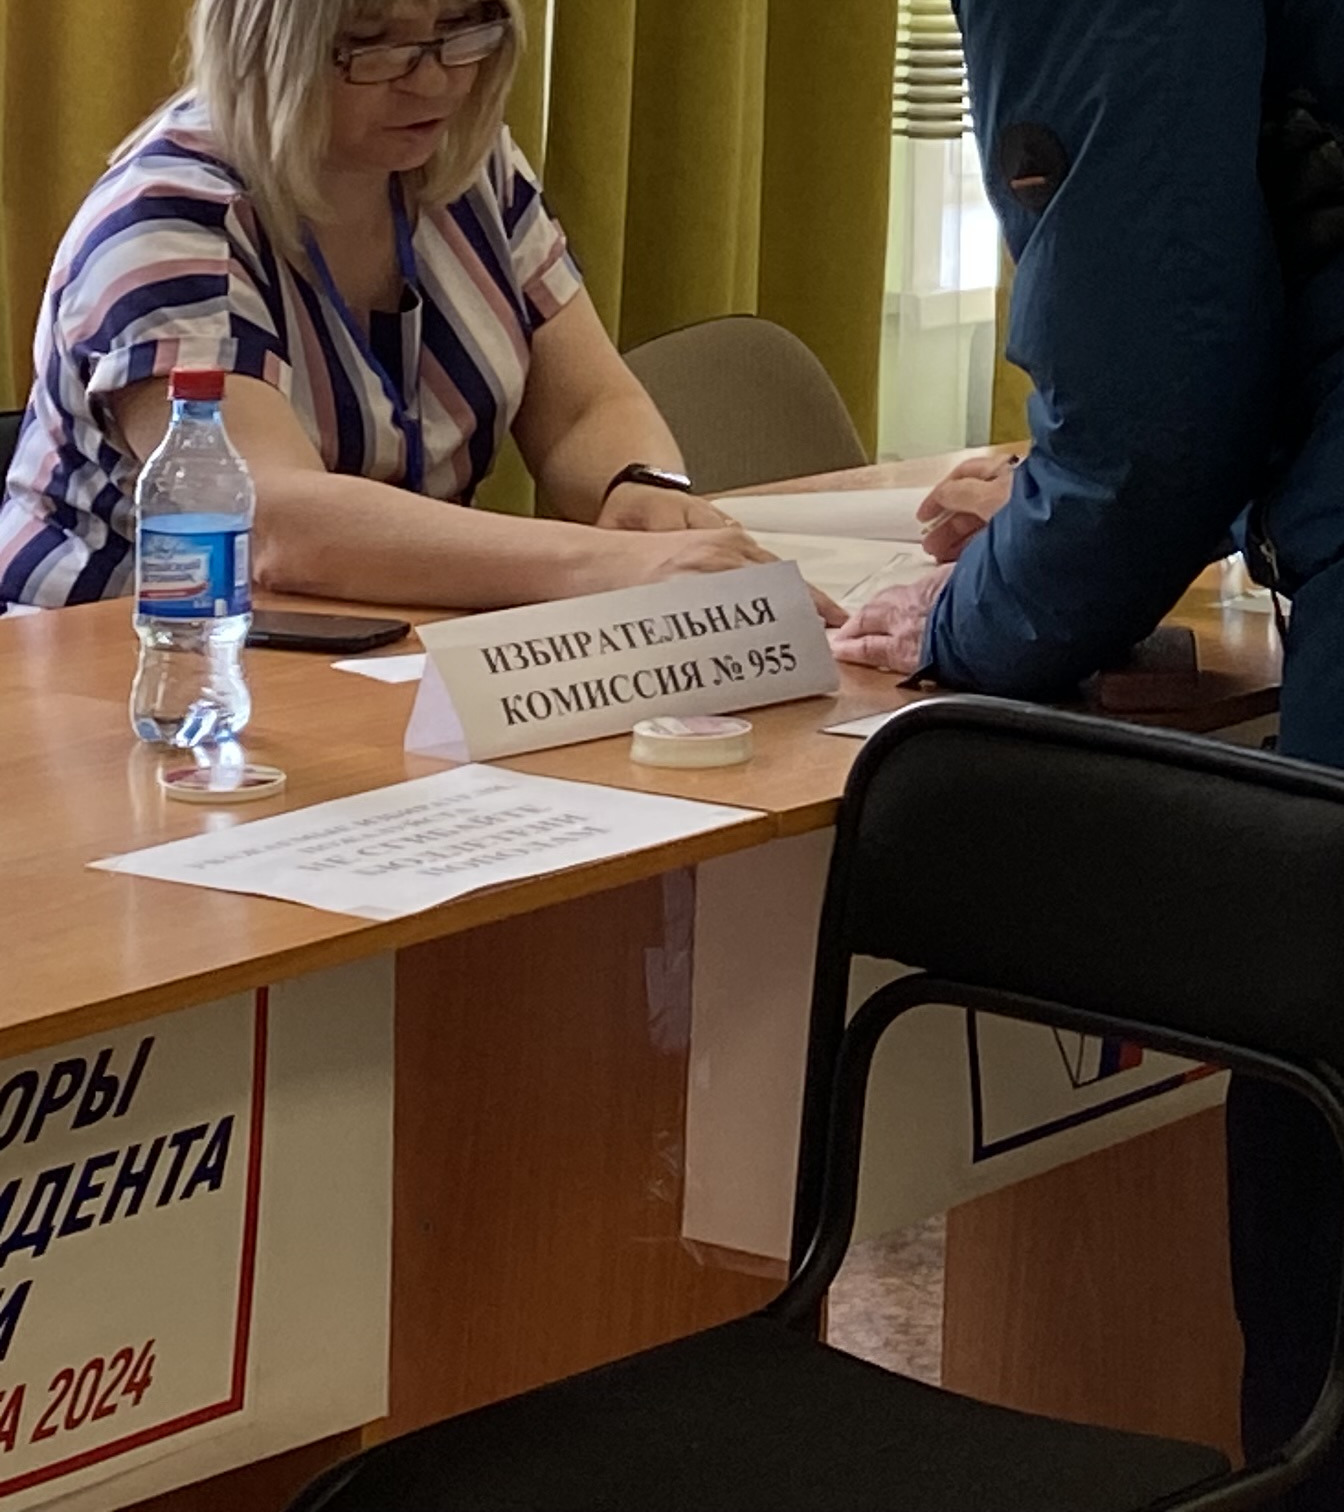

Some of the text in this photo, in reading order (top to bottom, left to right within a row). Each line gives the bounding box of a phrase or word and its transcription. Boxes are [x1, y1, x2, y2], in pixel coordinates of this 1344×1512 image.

[480, 597, 778, 675] ИЗБИРАТЕЛЬНАЯ
[499, 642, 798, 726] КОМИССИЯ № 955
[354, 803, 552, 859] СГИБАЙТЕ
[29, 1338, 156, 1444] 2024
